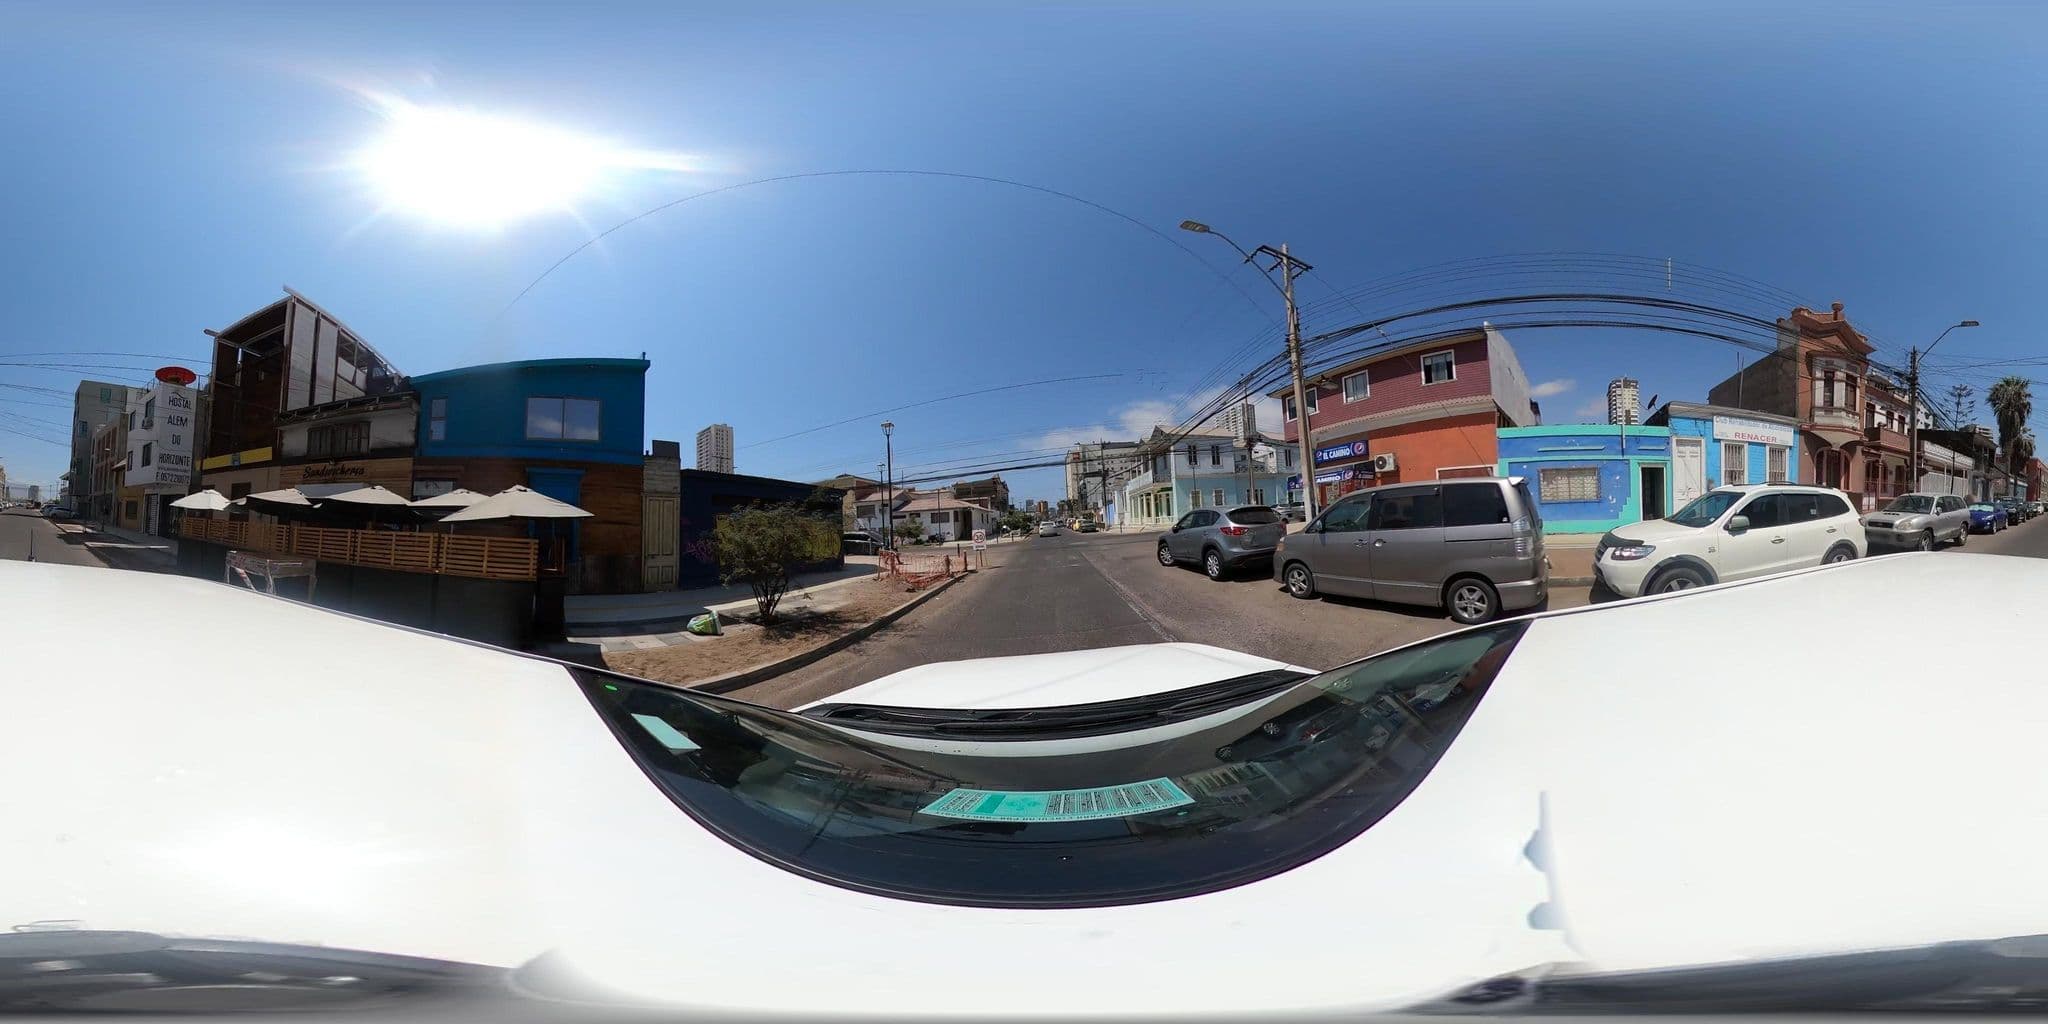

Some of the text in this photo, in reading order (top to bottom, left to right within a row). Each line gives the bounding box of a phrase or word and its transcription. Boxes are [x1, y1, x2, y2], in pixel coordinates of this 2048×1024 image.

[168, 396, 192, 409] HOSTAL
[167, 414, 188, 428] ALEM
[172, 434, 181, 446] DO
[1734, 432, 1776, 442] RENACER
[1329, 448, 1350, 458] CAMINO
[158, 453, 190, 466] HORIZONTE
